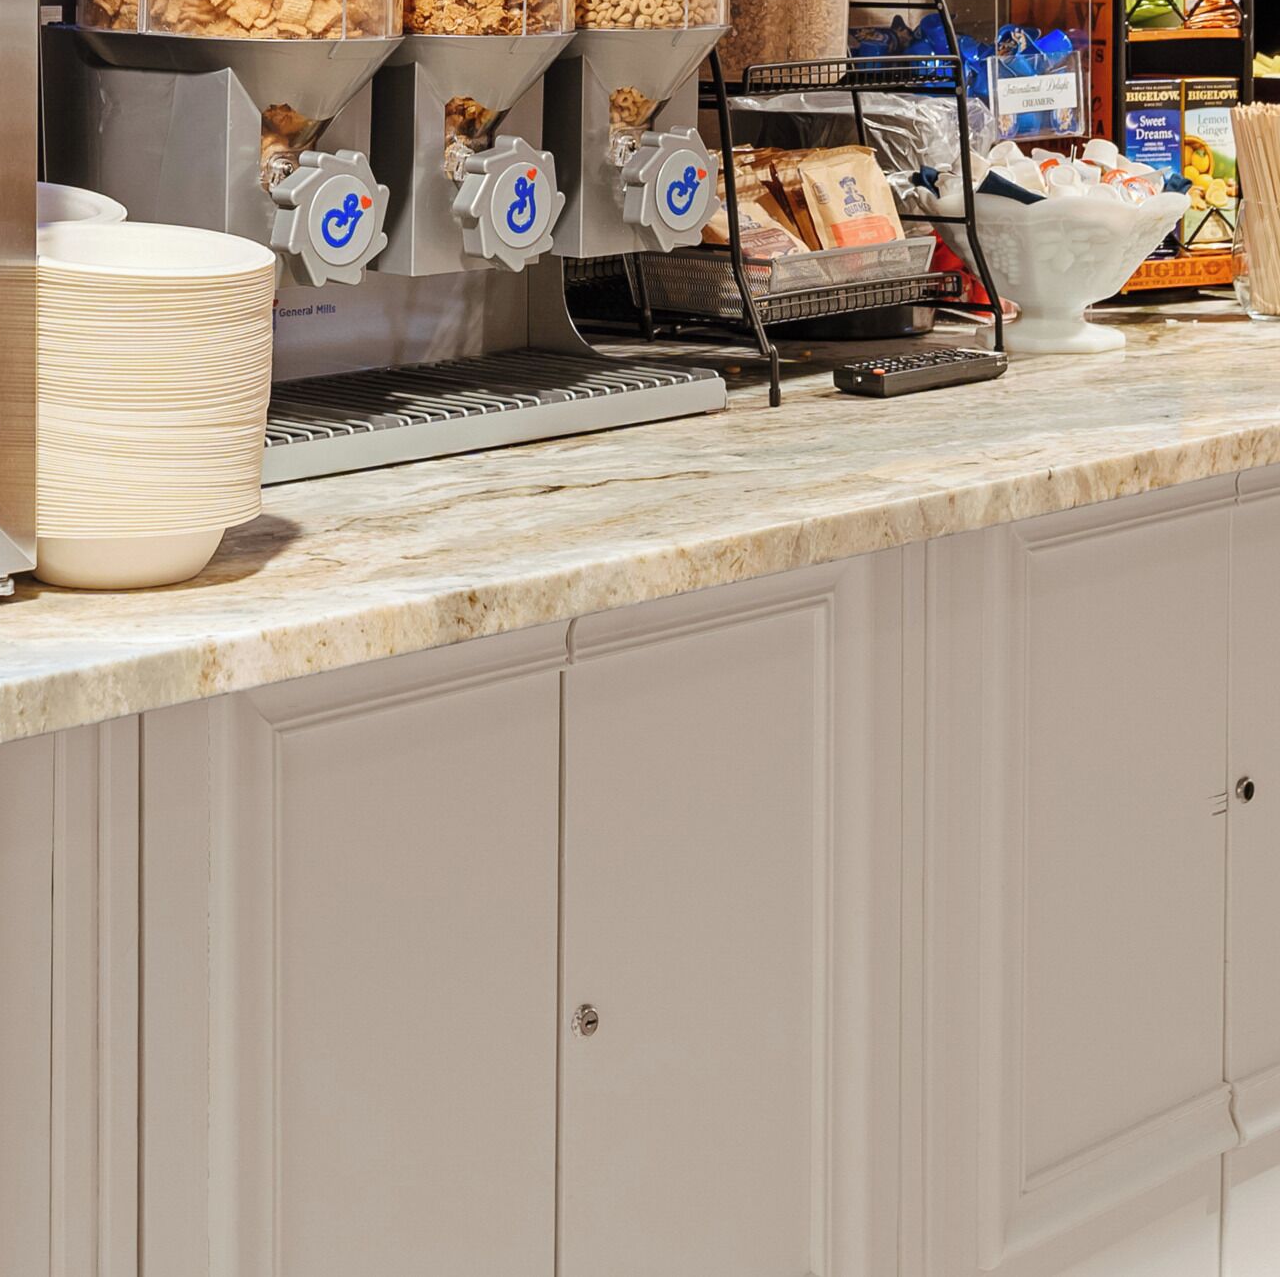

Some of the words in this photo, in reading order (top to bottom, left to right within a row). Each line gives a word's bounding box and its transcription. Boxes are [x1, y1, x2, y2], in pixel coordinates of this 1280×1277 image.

[1022, 98, 1054, 107] CREAMERS
[1140, 116, 1166, 126] Sweet
[1198, 115, 1227, 123] Lemon
[1136, 130, 1173, 140] Dreams
[1197, 126, 1228, 136] Ginger
[844, 203, 871, 217] QUAKER
[279, 305, 312, 317] General
[316, 304, 336, 314] Mills
